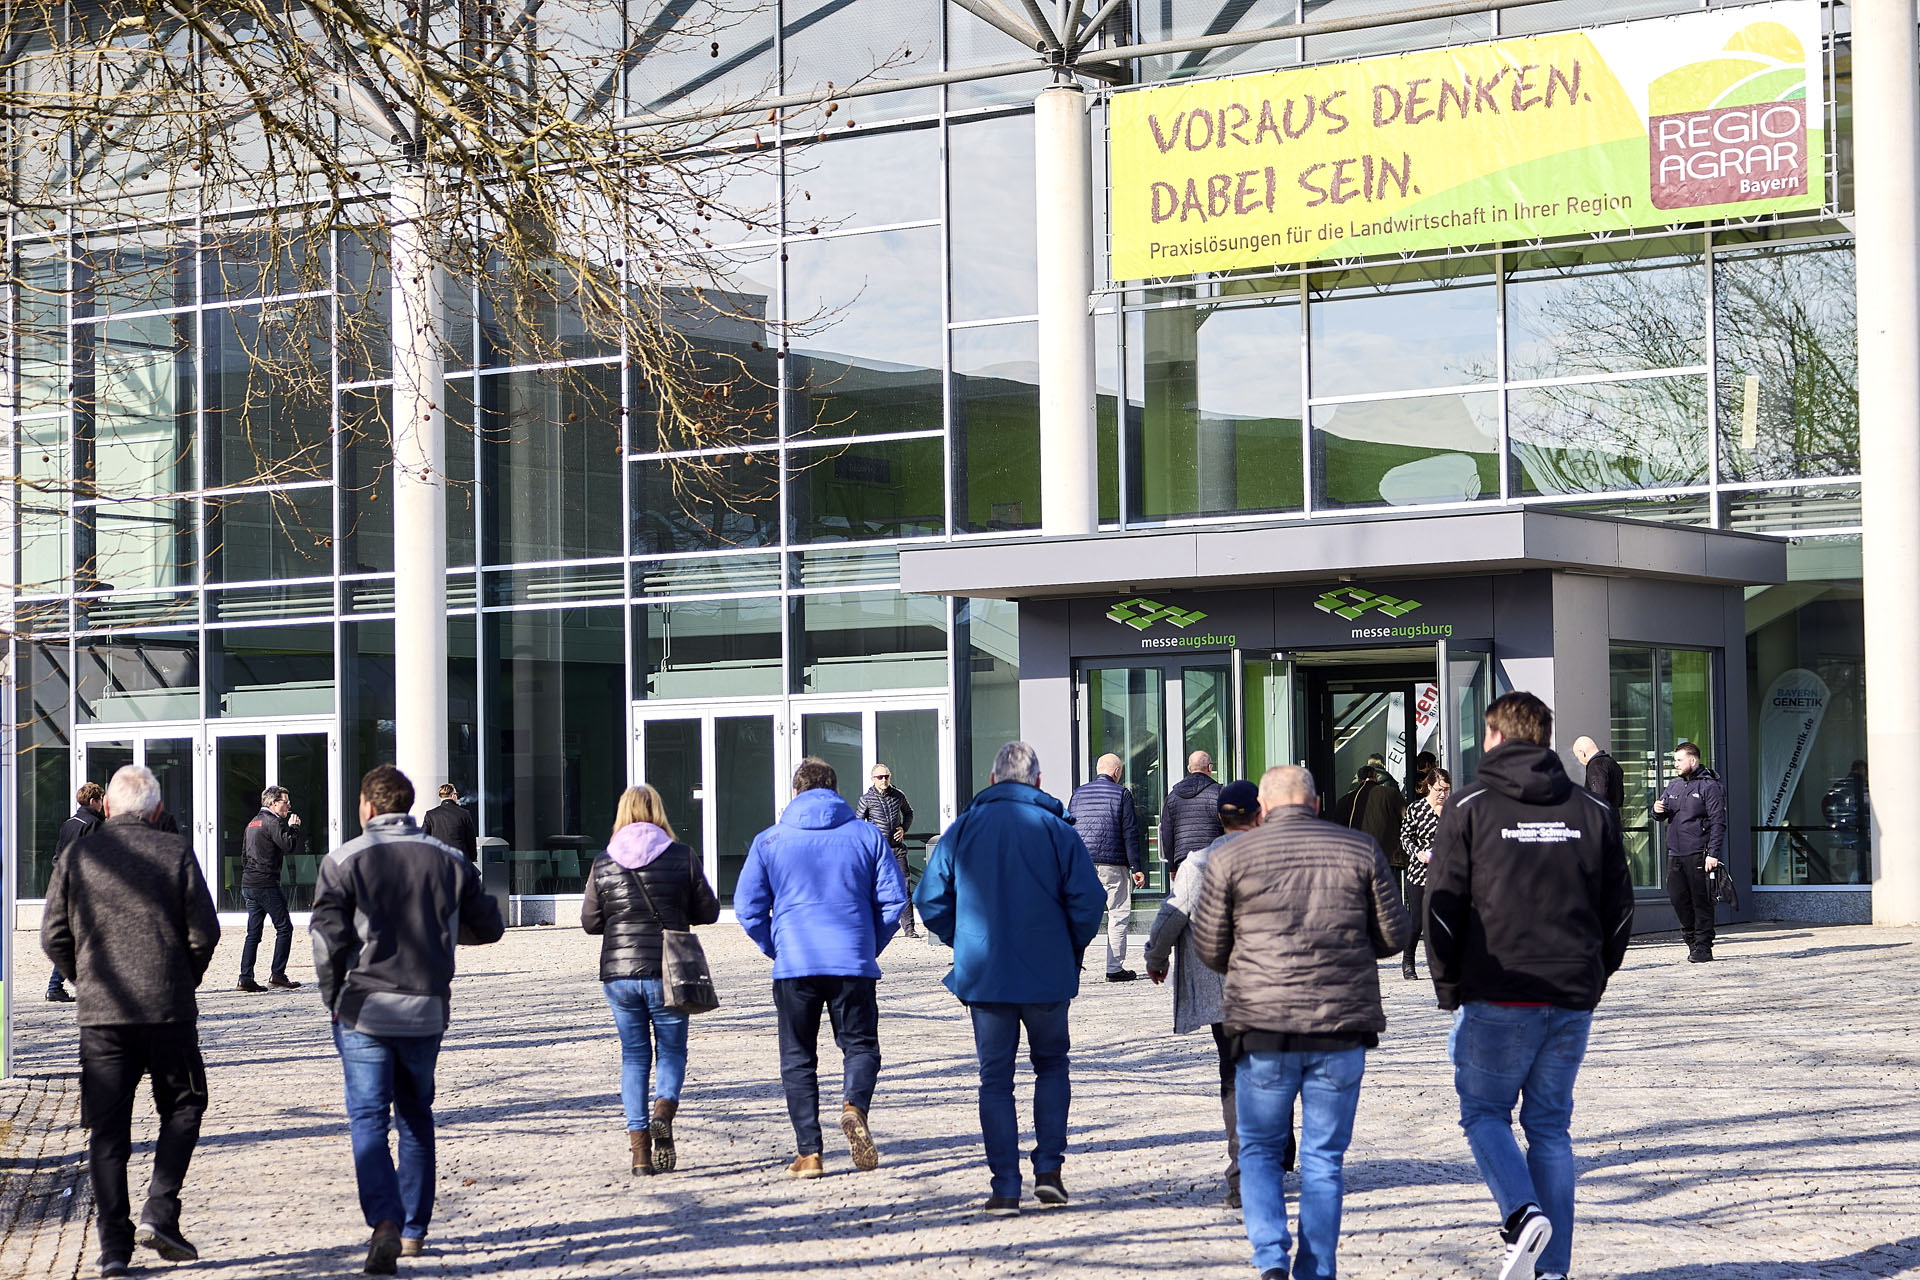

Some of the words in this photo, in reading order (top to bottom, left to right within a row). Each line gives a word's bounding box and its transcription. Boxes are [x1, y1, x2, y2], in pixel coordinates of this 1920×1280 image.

[1148, 90, 1349, 153] VORAUS
[1372, 58, 1592, 128] DENKEN.
[1659, 106, 1801, 151] REGIO
[1659, 141, 1799, 184] AGRAR
[1151, 166, 1276, 224] DABEI
[1298, 152, 1421, 207] SEIN.
[1740, 176, 1799, 195] Bayern
[1150, 231, 1281, 259] Praxislösungen
[1286, 226, 1312, 244] für
[1317, 223, 1344, 241] die
[1350, 207, 1486, 238] Landwirtschaft
[1492, 205, 1508, 222] in
[1514, 202, 1560, 221] Ihrer
[1567, 193, 1632, 216] Region
[1141, 633, 1236, 648] messeaugsburg
[1351, 622, 1453, 639] messeaugsburg
[1773, 697, 1823, 708] GENETIK
[1776, 688, 1818, 698] BAYERN
